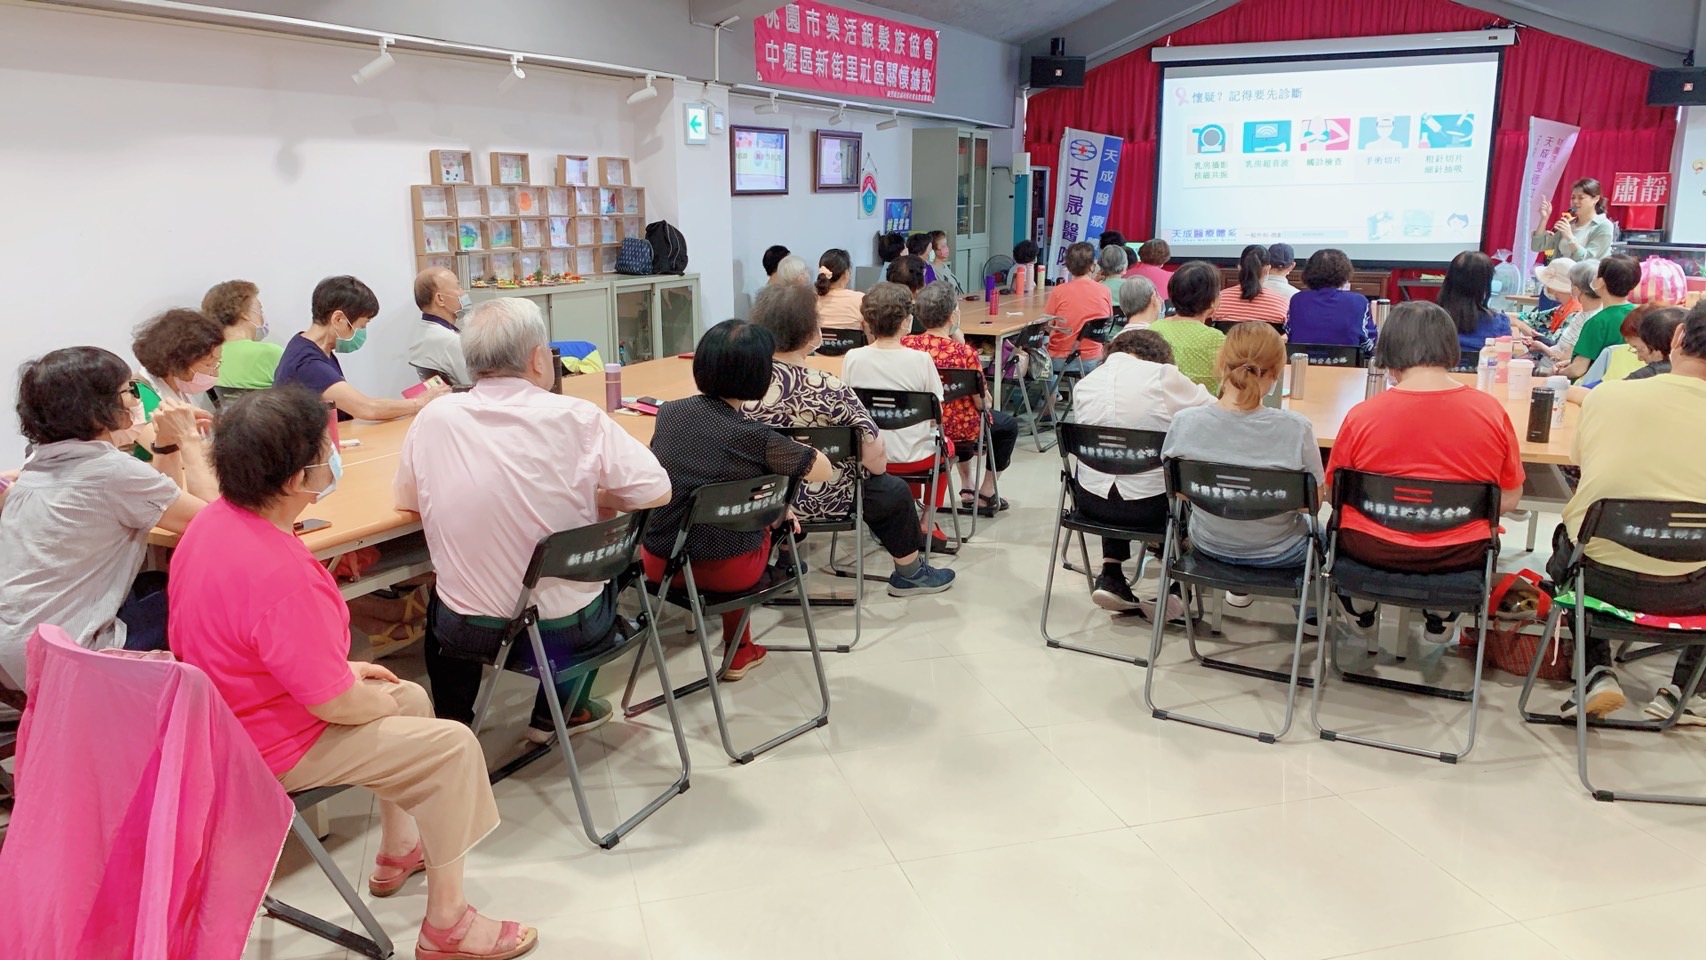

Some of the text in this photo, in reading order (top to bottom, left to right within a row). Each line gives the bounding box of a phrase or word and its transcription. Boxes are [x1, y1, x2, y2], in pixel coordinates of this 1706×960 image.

[1612, 175, 1667, 203] 肅靜
[1171, 228, 1237, 239] 天成醫療體系
